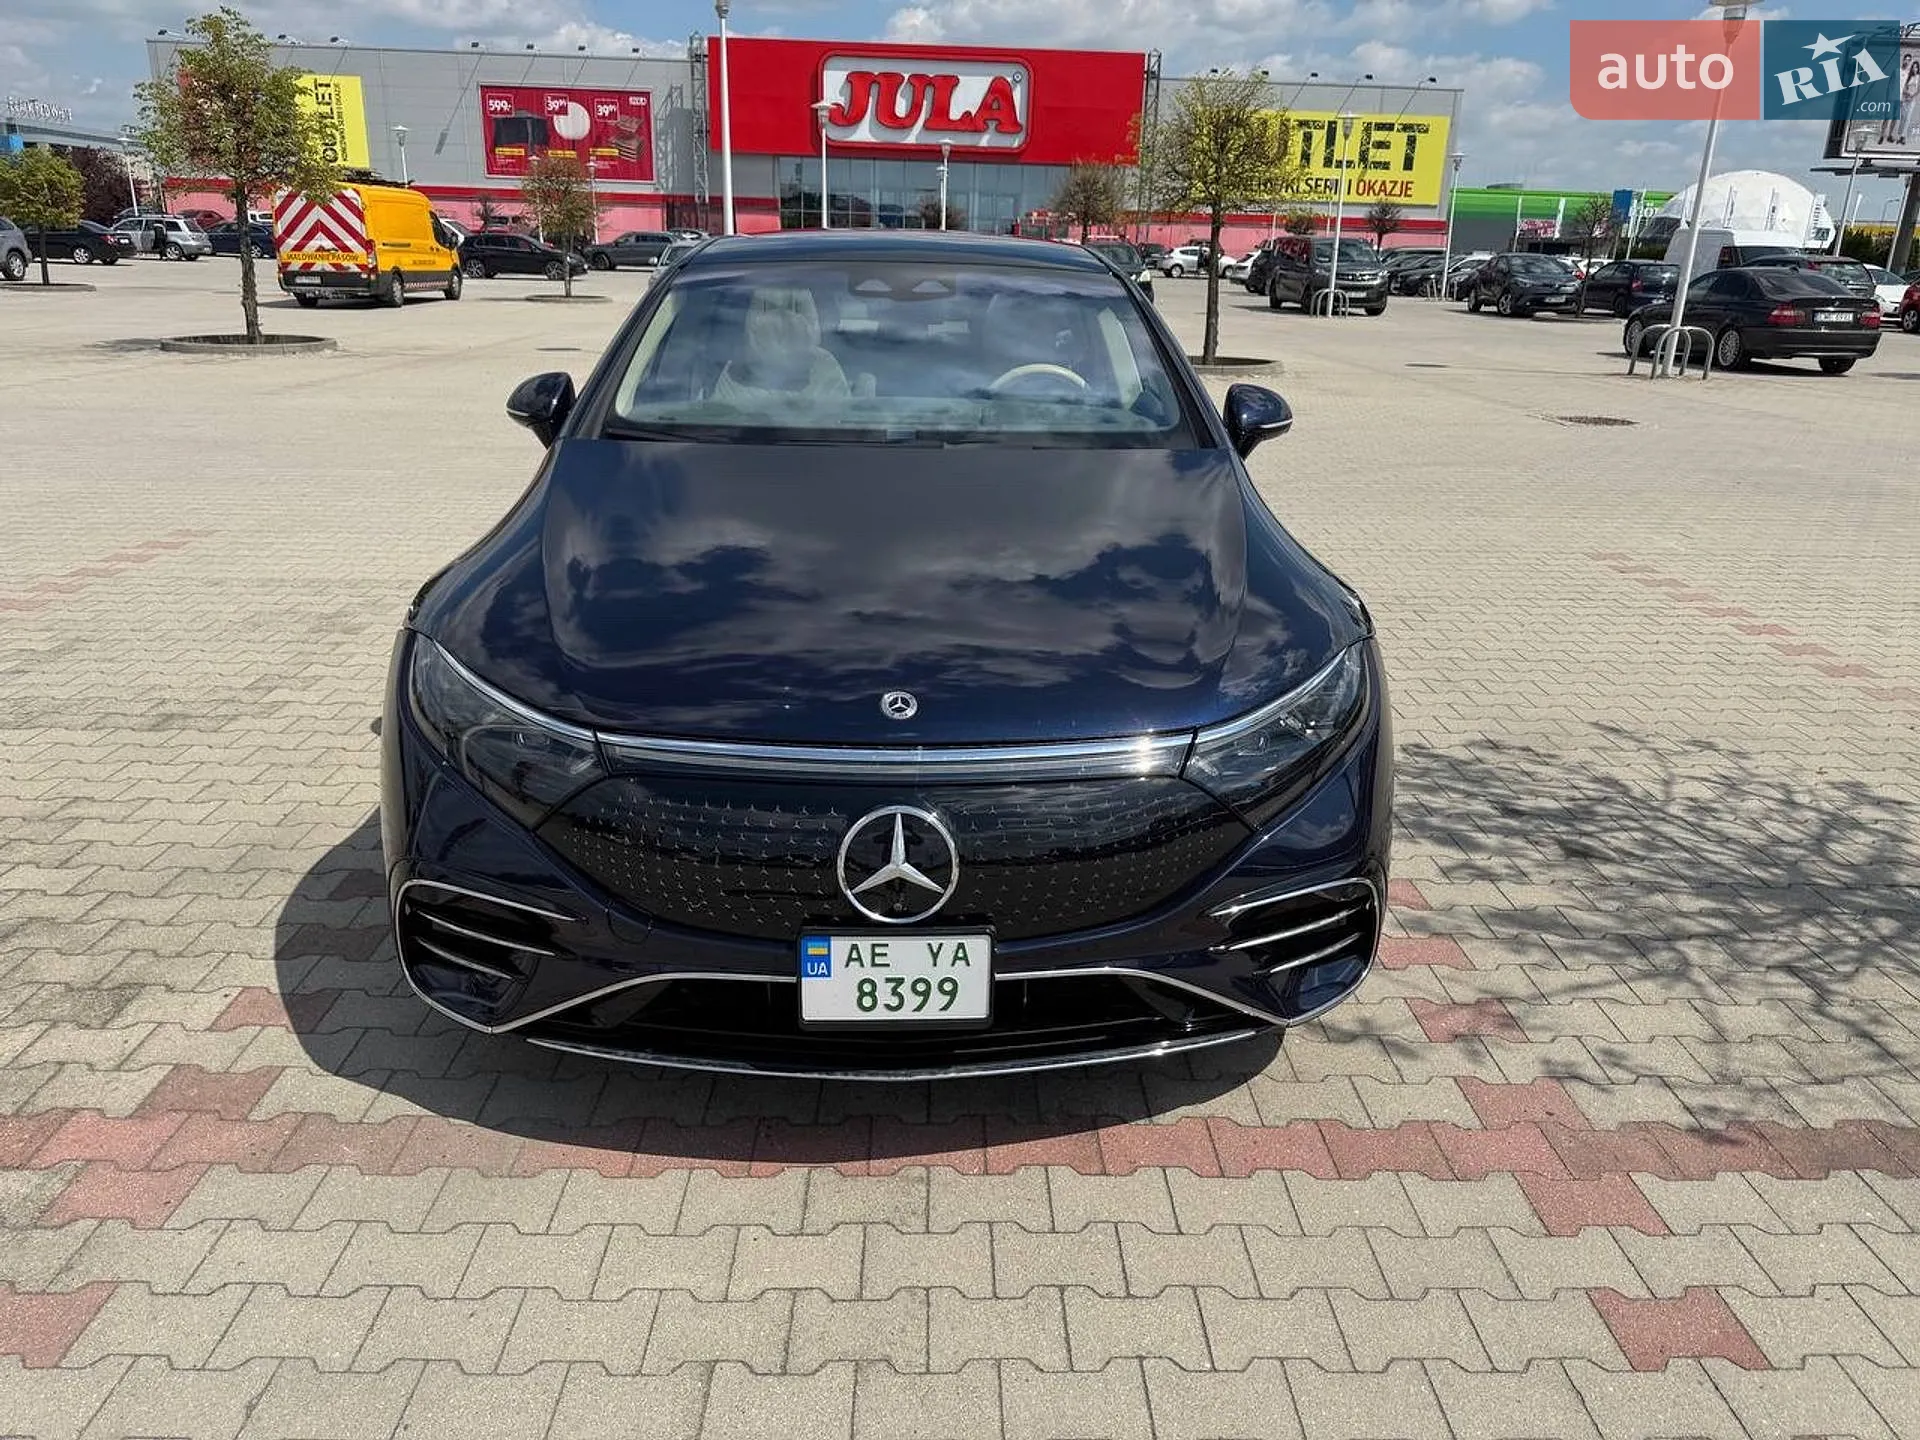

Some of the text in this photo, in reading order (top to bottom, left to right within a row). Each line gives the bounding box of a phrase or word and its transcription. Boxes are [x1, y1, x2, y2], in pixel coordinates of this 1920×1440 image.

[828, 71, 1023, 134] JULA
[1356, 178, 1415, 198] OKAZJE
[844, 942, 971, 968] AE YA
[807, 962, 829, 976] UA
[856, 976, 959, 1012] 8399
